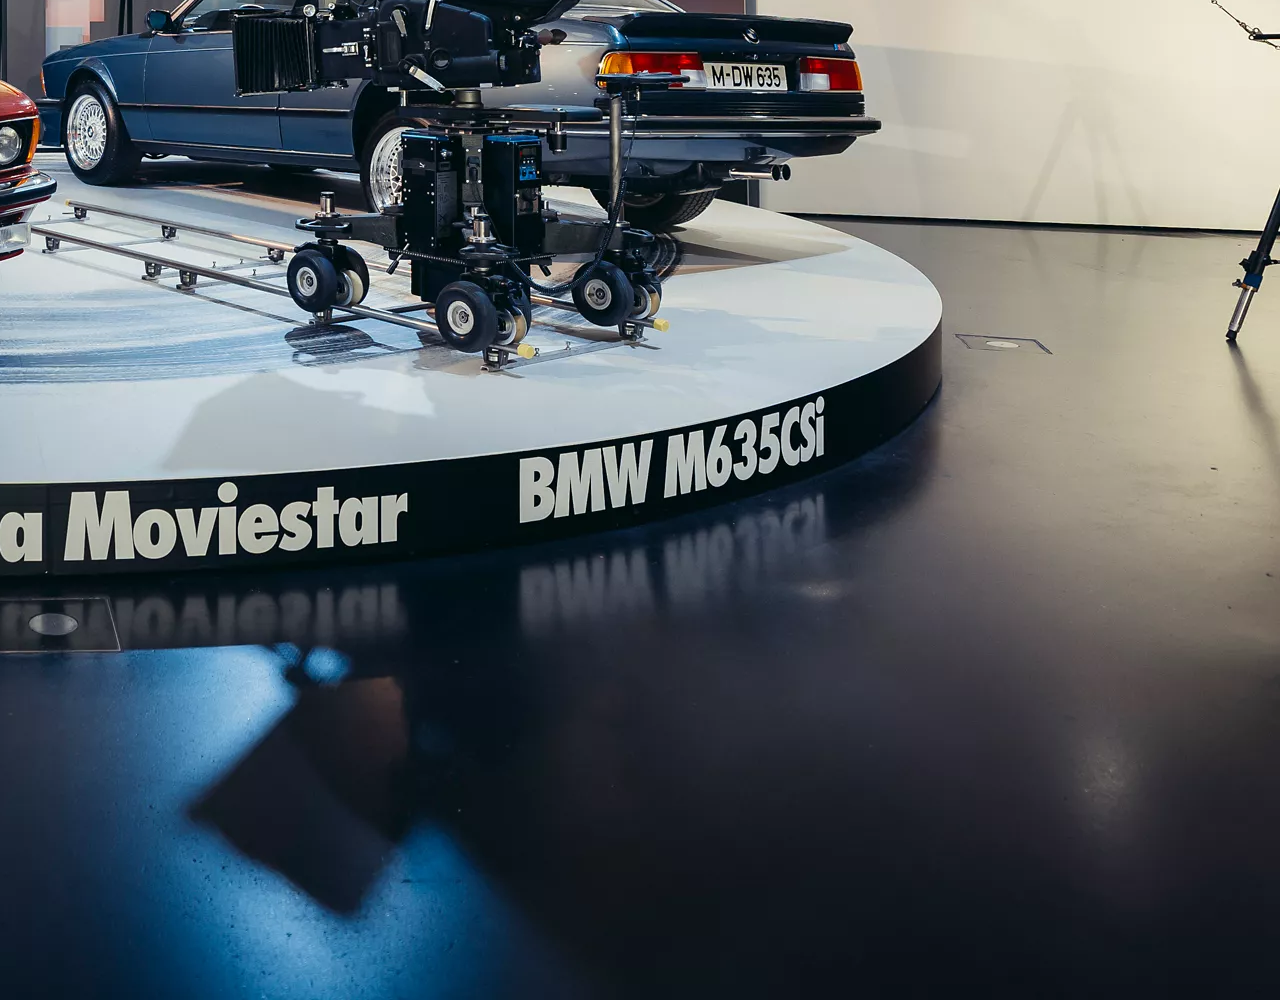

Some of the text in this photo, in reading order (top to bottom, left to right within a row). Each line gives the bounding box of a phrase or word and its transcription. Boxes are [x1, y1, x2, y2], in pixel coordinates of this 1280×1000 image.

[711, 65, 781, 88] M-DW 635
[519, 396, 825, 524] BMW M635CSi
[64, 481, 409, 562] Moviestar
